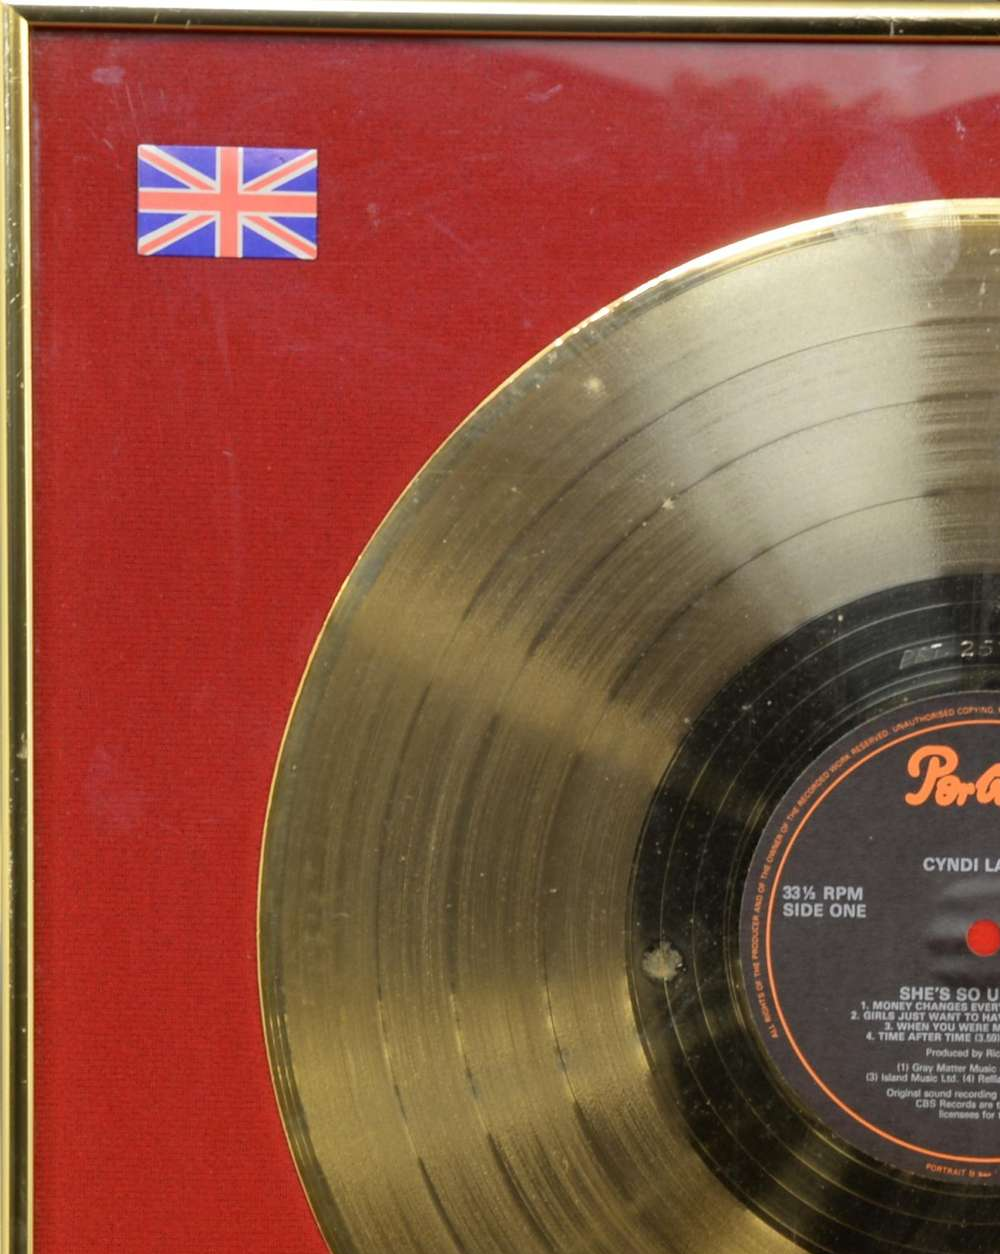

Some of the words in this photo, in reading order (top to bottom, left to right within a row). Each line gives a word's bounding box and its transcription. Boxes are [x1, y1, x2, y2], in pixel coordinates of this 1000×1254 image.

[923, 857, 978, 872] CYNDI
[824, 886, 864, 901] RPM
[783, 903, 823, 917] SIDE
[830, 904, 866, 918] ONE
[900, 987, 950, 1001] SHE'S
[956, 987, 980, 1002] SO
[860, 1002, 869, 1010] 1.
[873, 1002, 912, 1011] MONEY
[916, 1002, 968, 1012] CHANGES
[850, 1011, 860, 1020] 2.
[864, 1012, 896, 1021] GIRLS
[898, 1012, 926, 1021] JUST
[929, 1013, 962, 1022] WANT
[965, 1013, 979, 1022] TO
[884, 1022, 894, 1031] 3.
[897, 1022, 930, 1031] WHEN
[933, 1023, 956, 1032] YOU
[959, 1023, 990, 1032] WERE
[866, 1032, 875, 1040] 4.
[878, 1032, 904, 1041] TIME
[908, 1032, 941, 1041] AFTER
[945, 1033, 970, 1042] TIME
[926, 1048, 968, 1058] Produced
[972, 1049, 982, 1059] by
[897, 1063, 908, 1073] (1)
[912, 1063, 934, 1074] Gray
[936, 1064, 966, 1073] Matter
[970, 1064, 997, 1074] Music
[866, 1073, 878, 1082] (3)
[882, 1073, 908, 1082] Island
[911, 1074, 937, 1083] Music
[962, 1074, 974, 1084] (4)
[886, 1088, 920, 1099] Original
[924, 1089, 951, 1098] sound
[954, 1090, 998, 1100] recording
[915, 1099, 936, 1109] CBS
[940, 1100, 976, 1109] Records
[938, 1110, 980, 1119] licensees
[982, 1110, 995, 1120] for
